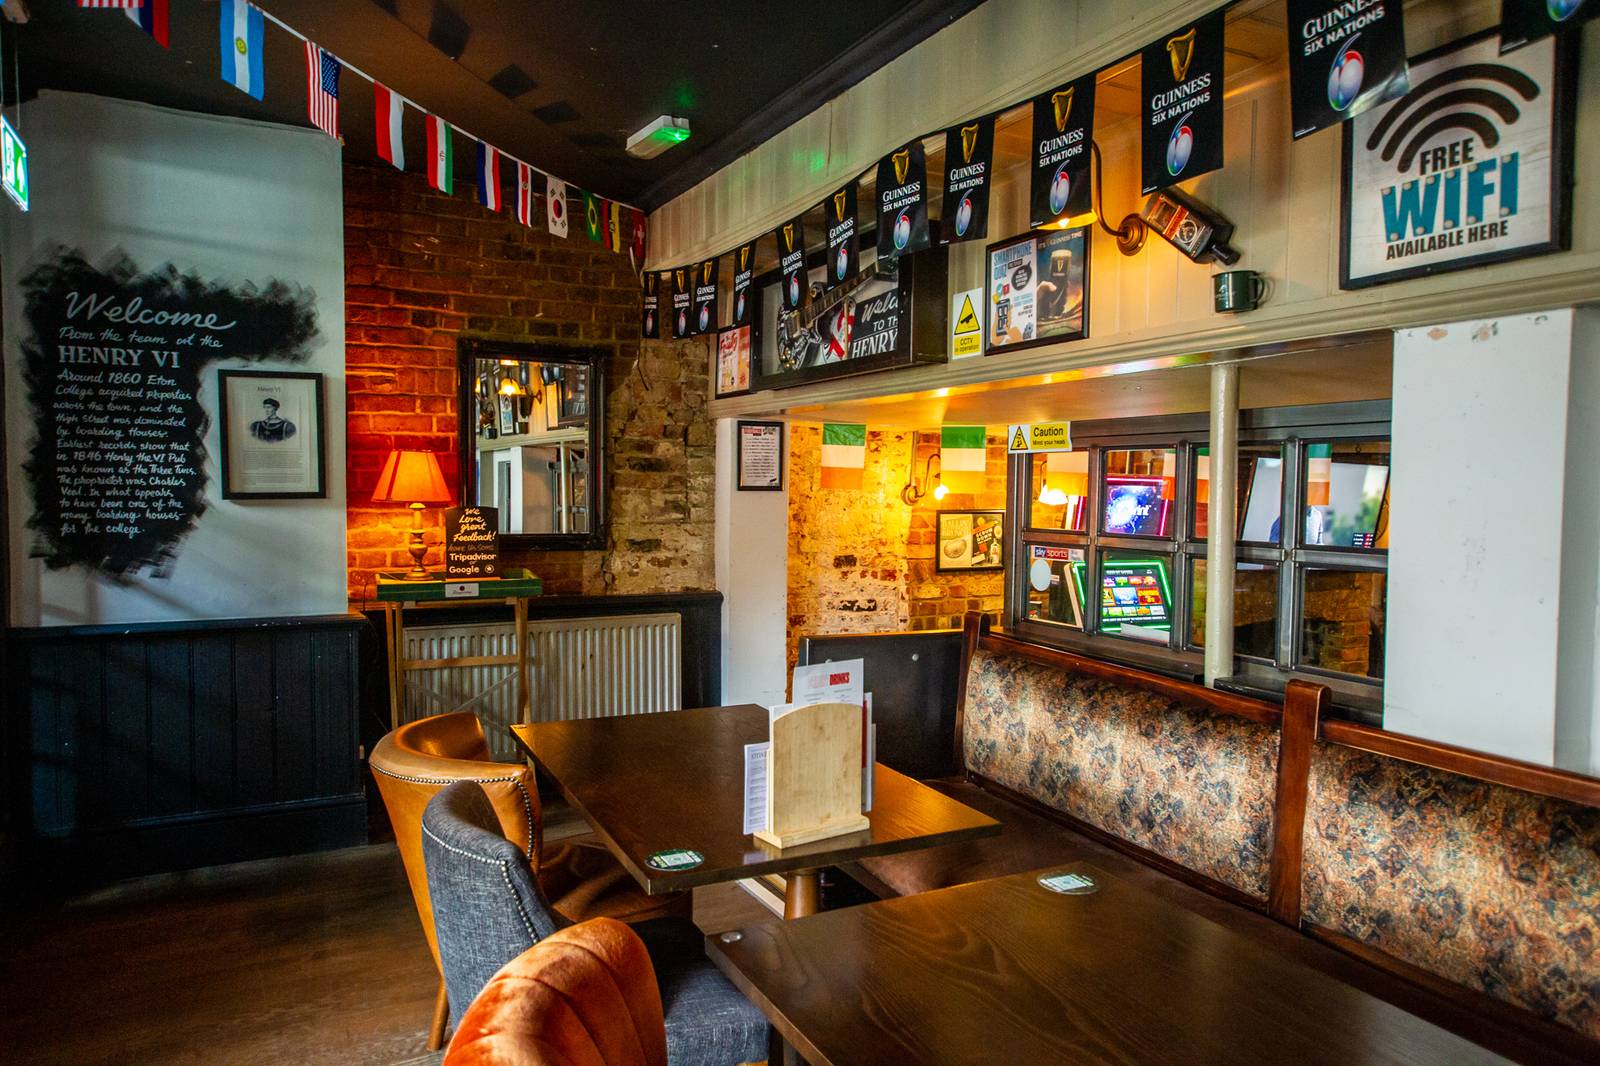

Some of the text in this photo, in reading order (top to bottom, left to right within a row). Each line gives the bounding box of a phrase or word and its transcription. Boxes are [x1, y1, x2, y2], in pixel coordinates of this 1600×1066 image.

[1303, 0, 1379, 39] GUINNE
[1304, 7, 1385, 56] SIX NATIONS
[1152, 73, 1211, 110] GUINNESS
[1152, 92, 1211, 126] SIX NATIONS
[1039, 128, 1084, 155] GUINNESS
[1039, 145, 1083, 168] SIX NATIONS
[1420, 137, 1474, 176] FREE
[949, 162, 985, 181] GUINNESS
[882, 181, 921, 202] GUINNESS
[949, 176, 984, 193] SIX NATIONS
[882, 194, 920, 212] SIX NATIONS
[1381, 152, 1519, 243] WIFI
[829, 217, 854, 238] GUINNESS
[837, 228, 854, 244] NATIONS
[1386, 220, 1508, 260] AVAILABLE HERE
[782, 250, 802, 267] GUINNESS
[65, 291, 237, 330] Welcome
[873, 320, 885, 333] TO
[59, 326, 223, 348] From the team at the
[852, 329, 898, 358] HENRY
[57, 345, 181, 368] HENRY VI
[56, 368, 177, 386] Around 1860 Eton
[55, 385, 192, 401] College acquired properties
[52, 402, 84, 410] across
[87, 401, 104, 411] the
[140, 404, 162, 413] and
[167, 404, 184, 414] the
[56, 413, 78, 422] High
[134, 416, 186, 427] dominated
[56, 426, 70, 436] by
[75, 427, 125, 440] boarding
[1033, 427, 1064, 437] Caution
[98, 442, 137, 450] records
[140, 442, 167, 450] show
[170, 442, 191, 451] that
[56, 451, 187, 466] in 1846 Henry the VI Pub
[81, 464, 114, 473] known
[132, 465, 149, 475] the
[149, 464, 173, 475] Three
[56, 474, 72, 484] The
[148, 477, 187, 486] Charles
[90, 488, 100, 496] In
[105, 488, 132, 496] what
[135, 489, 174, 500] appears
[60, 499, 71, 507] to
[73, 499, 97, 507] have
[100, 499, 123, 508] been
[152, 499, 165, 511] of
[167, 499, 184, 508] the
[60, 512, 91, 524] many
[96, 509, 141, 523] boarding
[459, 515, 485, 523] Love
[60, 523, 76, 537] for
[85, 523, 100, 533] the
[453, 531, 497, 542] Feedback!
[449, 553, 497, 562] Tripadvisor
[1035, 548, 1046, 557] sky
[1047, 549, 1067, 558] sports
[448, 566, 480, 575] Google
